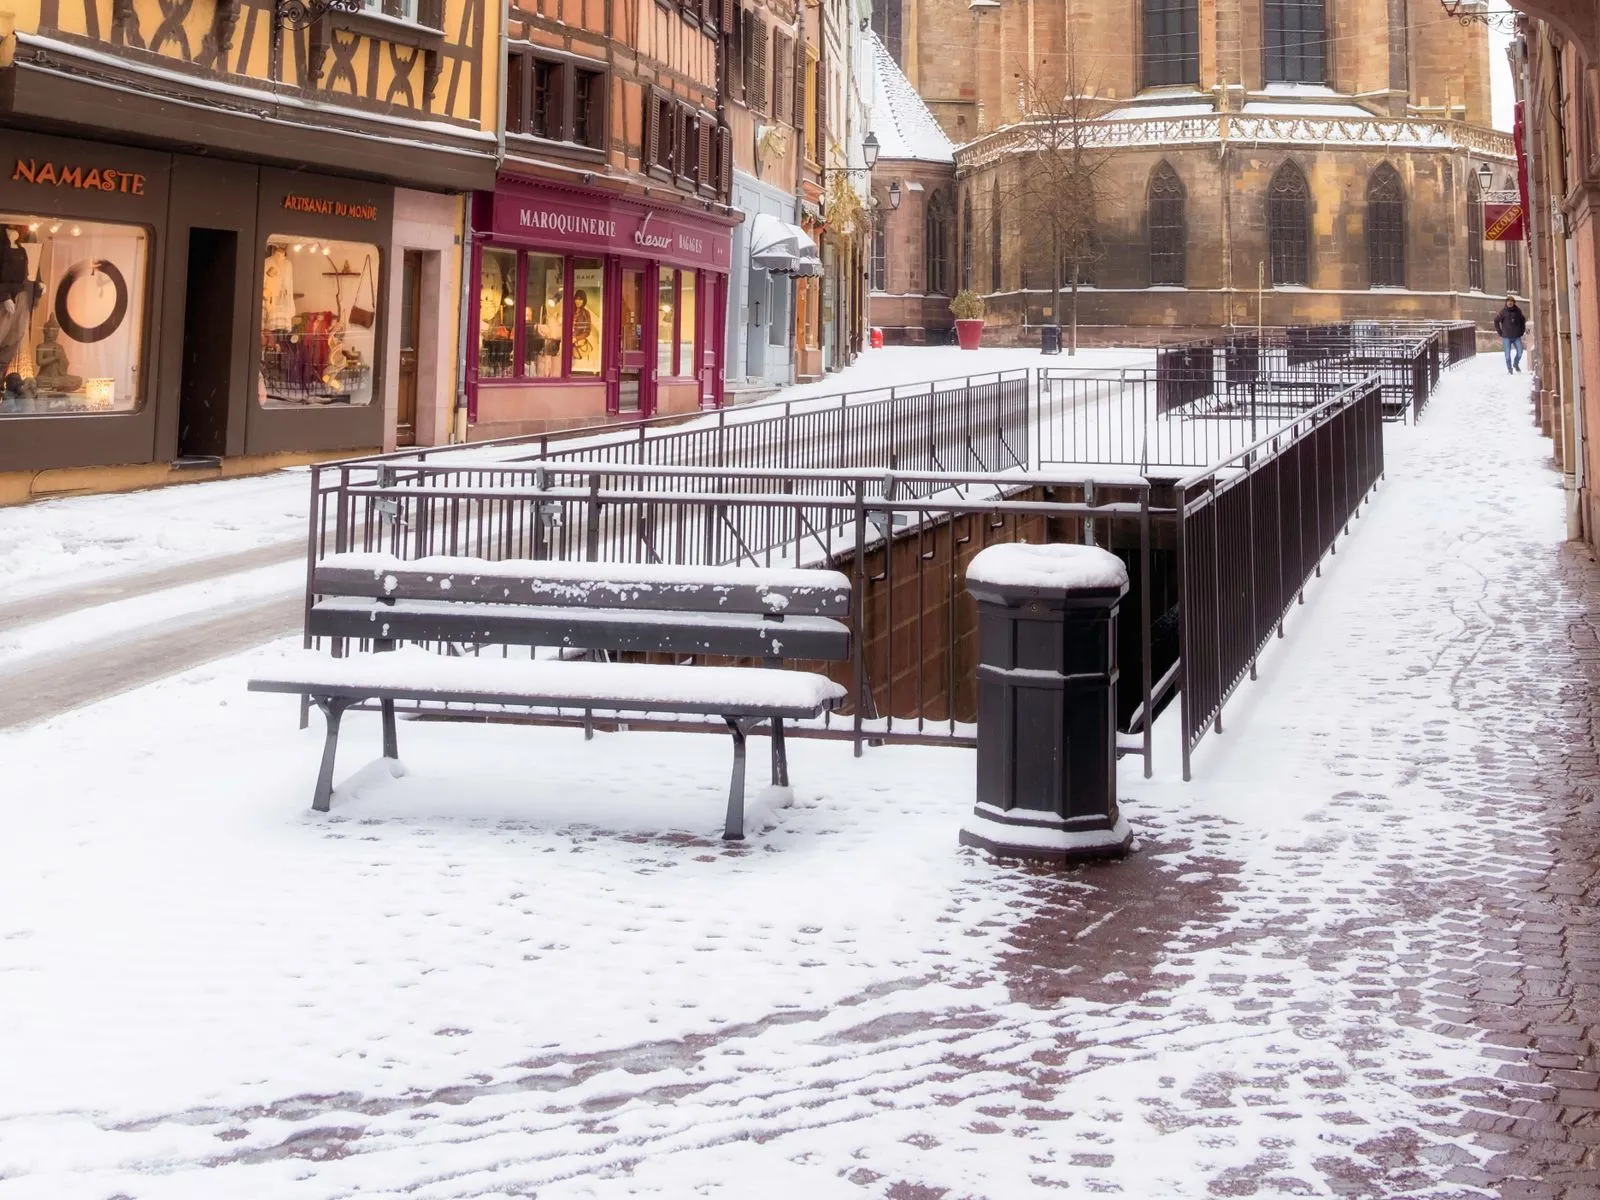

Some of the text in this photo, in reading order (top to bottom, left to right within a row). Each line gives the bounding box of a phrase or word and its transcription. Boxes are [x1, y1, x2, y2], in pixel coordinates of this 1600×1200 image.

[12, 159, 146, 195] NAMASTE
[284, 194, 377, 220] ARTISANAT DU MONDE
[520, 209, 616, 237] MAROQUINERIE
[1487, 206, 1520, 238] NICOLAS
[634, 211, 672, 248] Lesur
